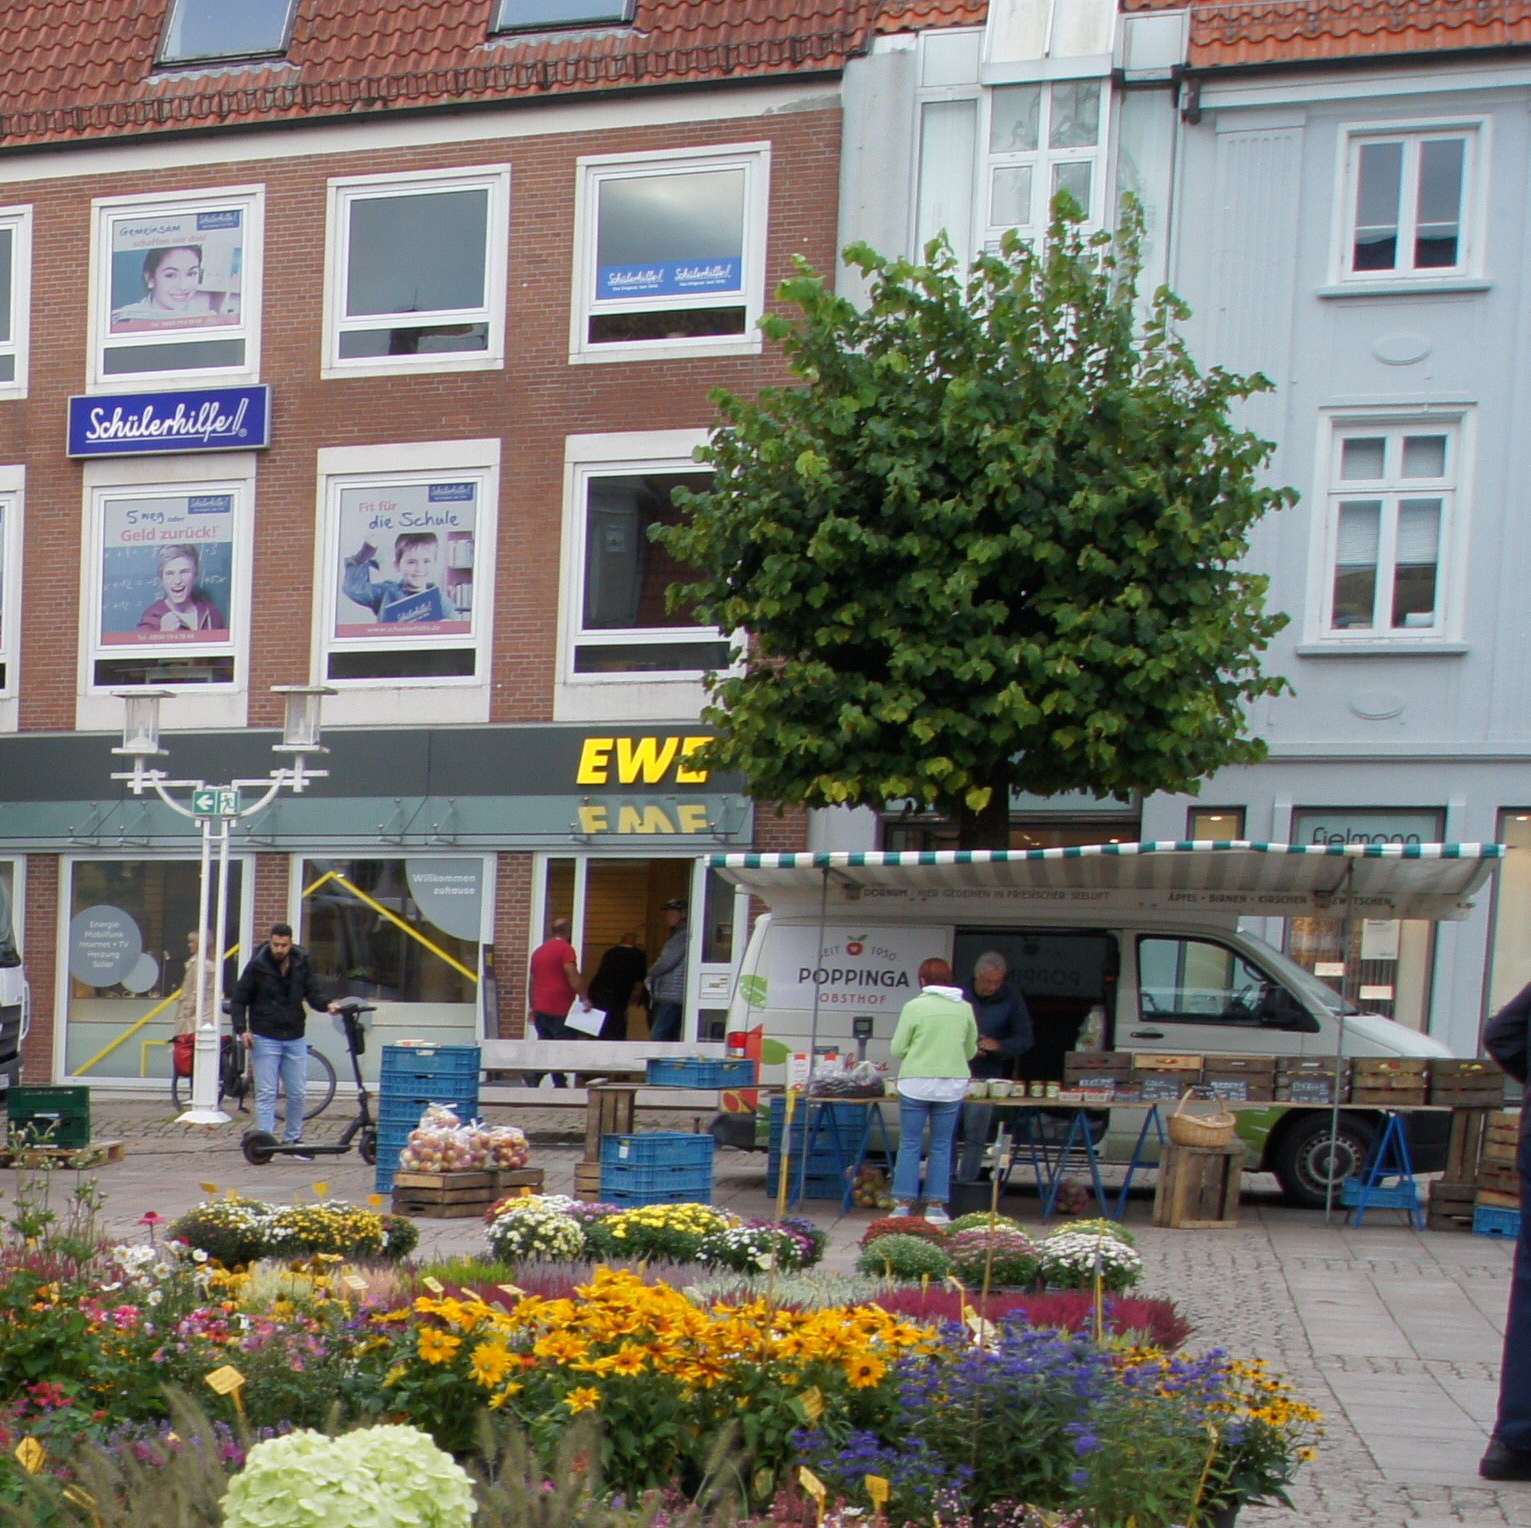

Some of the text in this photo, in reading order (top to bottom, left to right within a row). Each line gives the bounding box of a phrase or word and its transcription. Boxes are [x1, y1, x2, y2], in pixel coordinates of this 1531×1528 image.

[119, 224, 182, 237] Gemeinsam
[85, 397, 250, 443] Schülerhilfe!
[358, 500, 397, 513] Fit für
[368, 510, 459, 530] die Schule
[120, 527, 156, 542] Geld
[576, 736, 715, 785] EWE
[412, 873, 476, 883] Willkommen
[433, 886, 476, 895] zuhause
[863, 888, 908, 898] DORNUM
[89, 920, 120, 930] Energie
[798, 967, 910, 988] POPPINGA
[818, 992, 888, 1005] OBSTHOF
